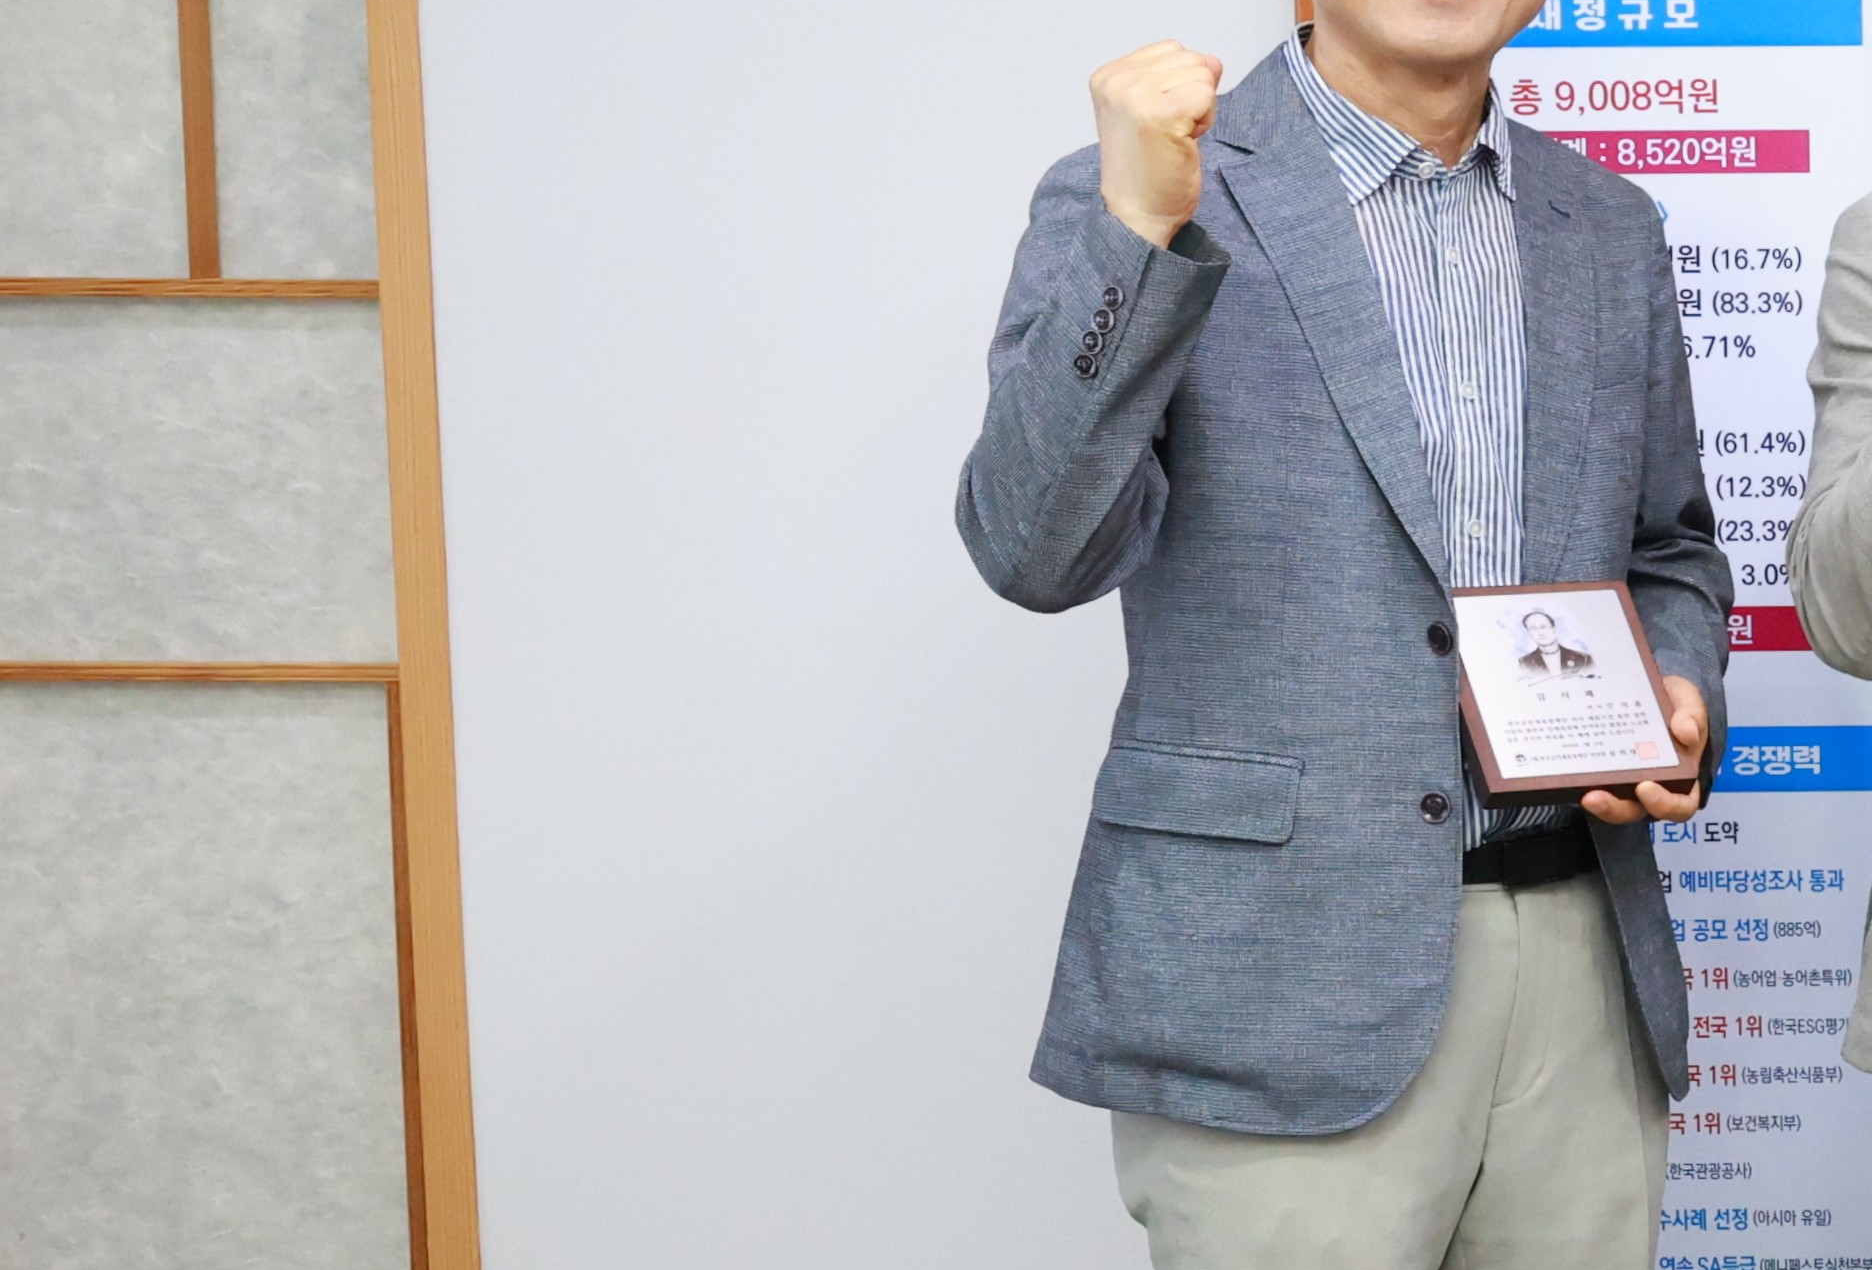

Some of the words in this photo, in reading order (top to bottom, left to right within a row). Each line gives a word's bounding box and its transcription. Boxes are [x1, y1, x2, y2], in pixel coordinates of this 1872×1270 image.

[1509, 79, 1542, 116] 총
[1554, 78, 1719, 116] 9,008억원
[1617, 136, 1758, 170] 8,520억원
[1711, 246, 1802, 274] (16.7%)
[1712, 289, 1803, 317] (83.3%)
[1715, 430, 1806, 457] (61.4%)
[1715, 473, 1808, 502] (12.3%)
[1731, 743, 1823, 777] 경쟁력
[1660, 820, 1697, 844] 도시
[1703, 821, 1739, 845] 도약
[1677, 869, 1804, 893] 예비타당성조사
[1808, 869, 1846, 893] 통과
[1690, 918, 1729, 942] 공모
[1732, 918, 1770, 942] 선정
[1772, 919, 1822, 940] (885억)
[1701, 967, 1729, 990] 1위
[1692, 1015, 1728, 1039] 전국
[1735, 1015, 1763, 1038] 1위
[1708, 1063, 1737, 1087] 1위
[1741, 1065, 1844, 1085] (농림축산식품부)
[1693, 1112, 1721, 1135] 1위
[1726, 1114, 1802, 1133] (보건복지부)
[1664, 1161, 1754, 1181] (한국관광공사)
[1712, 1207, 1749, 1231] 선정
[1752, 1208, 1797, 1227] (아시아
[1799, 1208, 1832, 1228] 유일)
